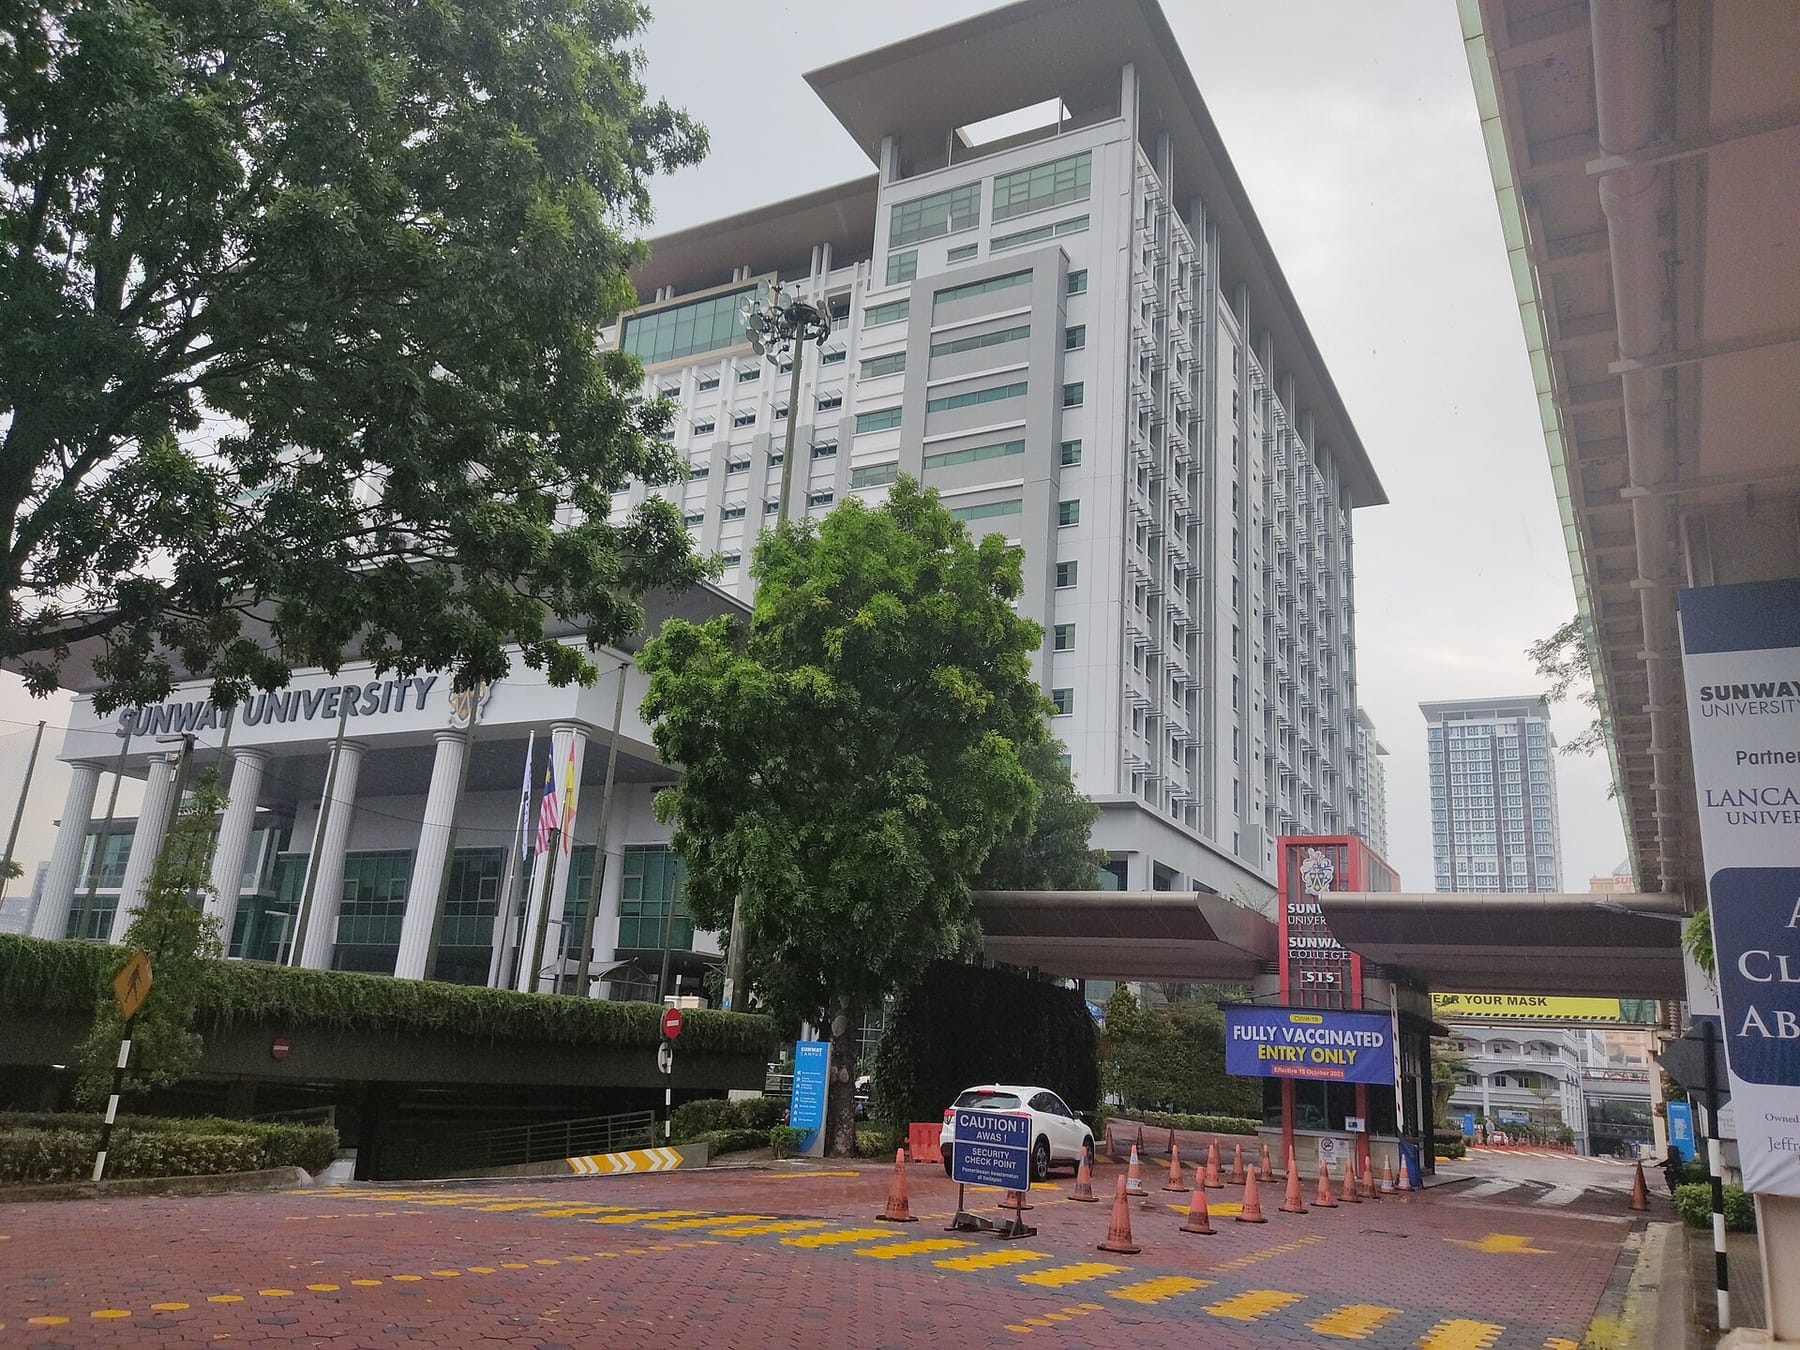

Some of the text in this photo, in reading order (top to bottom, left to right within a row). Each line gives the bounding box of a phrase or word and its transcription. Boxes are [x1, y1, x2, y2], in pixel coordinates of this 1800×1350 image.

[242, 676, 438, 726] UNIVERSITY
[1288, 937, 1345, 948] SUNWA
[1430, 994, 1547, 1006] EAR YOUR MASK
[1233, 1025, 1384, 1048] FULLY VACCINATED
[1258, 1044, 1358, 1066] ENTRY ONLY
[960, 1114, 1017, 1132] CAUTION
[1765, 1113, 1799, 1123] Owned
[976, 1131, 1002, 1142] AWAS
[1768, 1136, 1800, 1152] Jeffr
[972, 1147, 1010, 1159] SECURITY
[964, 1155, 1017, 1170] CHECK POINT
